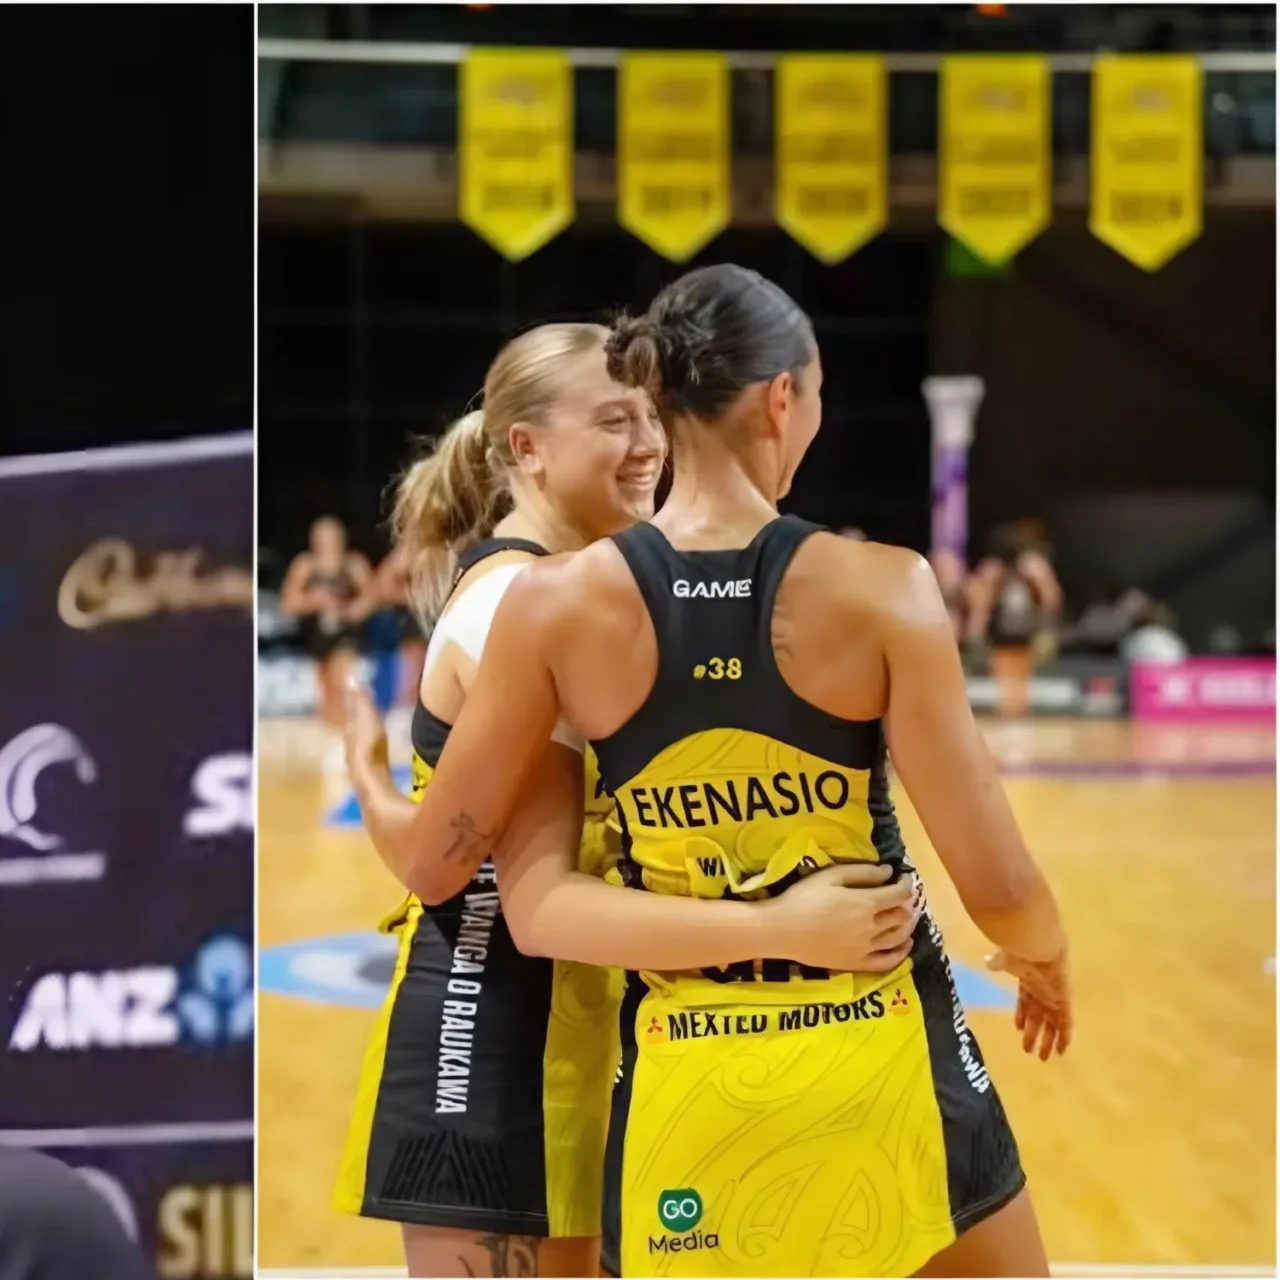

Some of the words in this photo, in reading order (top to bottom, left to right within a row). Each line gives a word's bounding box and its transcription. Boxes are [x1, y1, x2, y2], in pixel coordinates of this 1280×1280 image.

[673, 579, 752, 598] GAME
[630, 770, 849, 829] EKENASIO
[447, 978, 482, 995] O
[8, 966, 179, 1052] ANZ
[667, 1012, 768, 1041] MEXTED
[778, 990, 885, 1032] MOTORS
[435, 1000, 478, 1114] RAUKAWA
[663, 1198, 698, 1220] GO
[648, 1229, 719, 1256] Media
